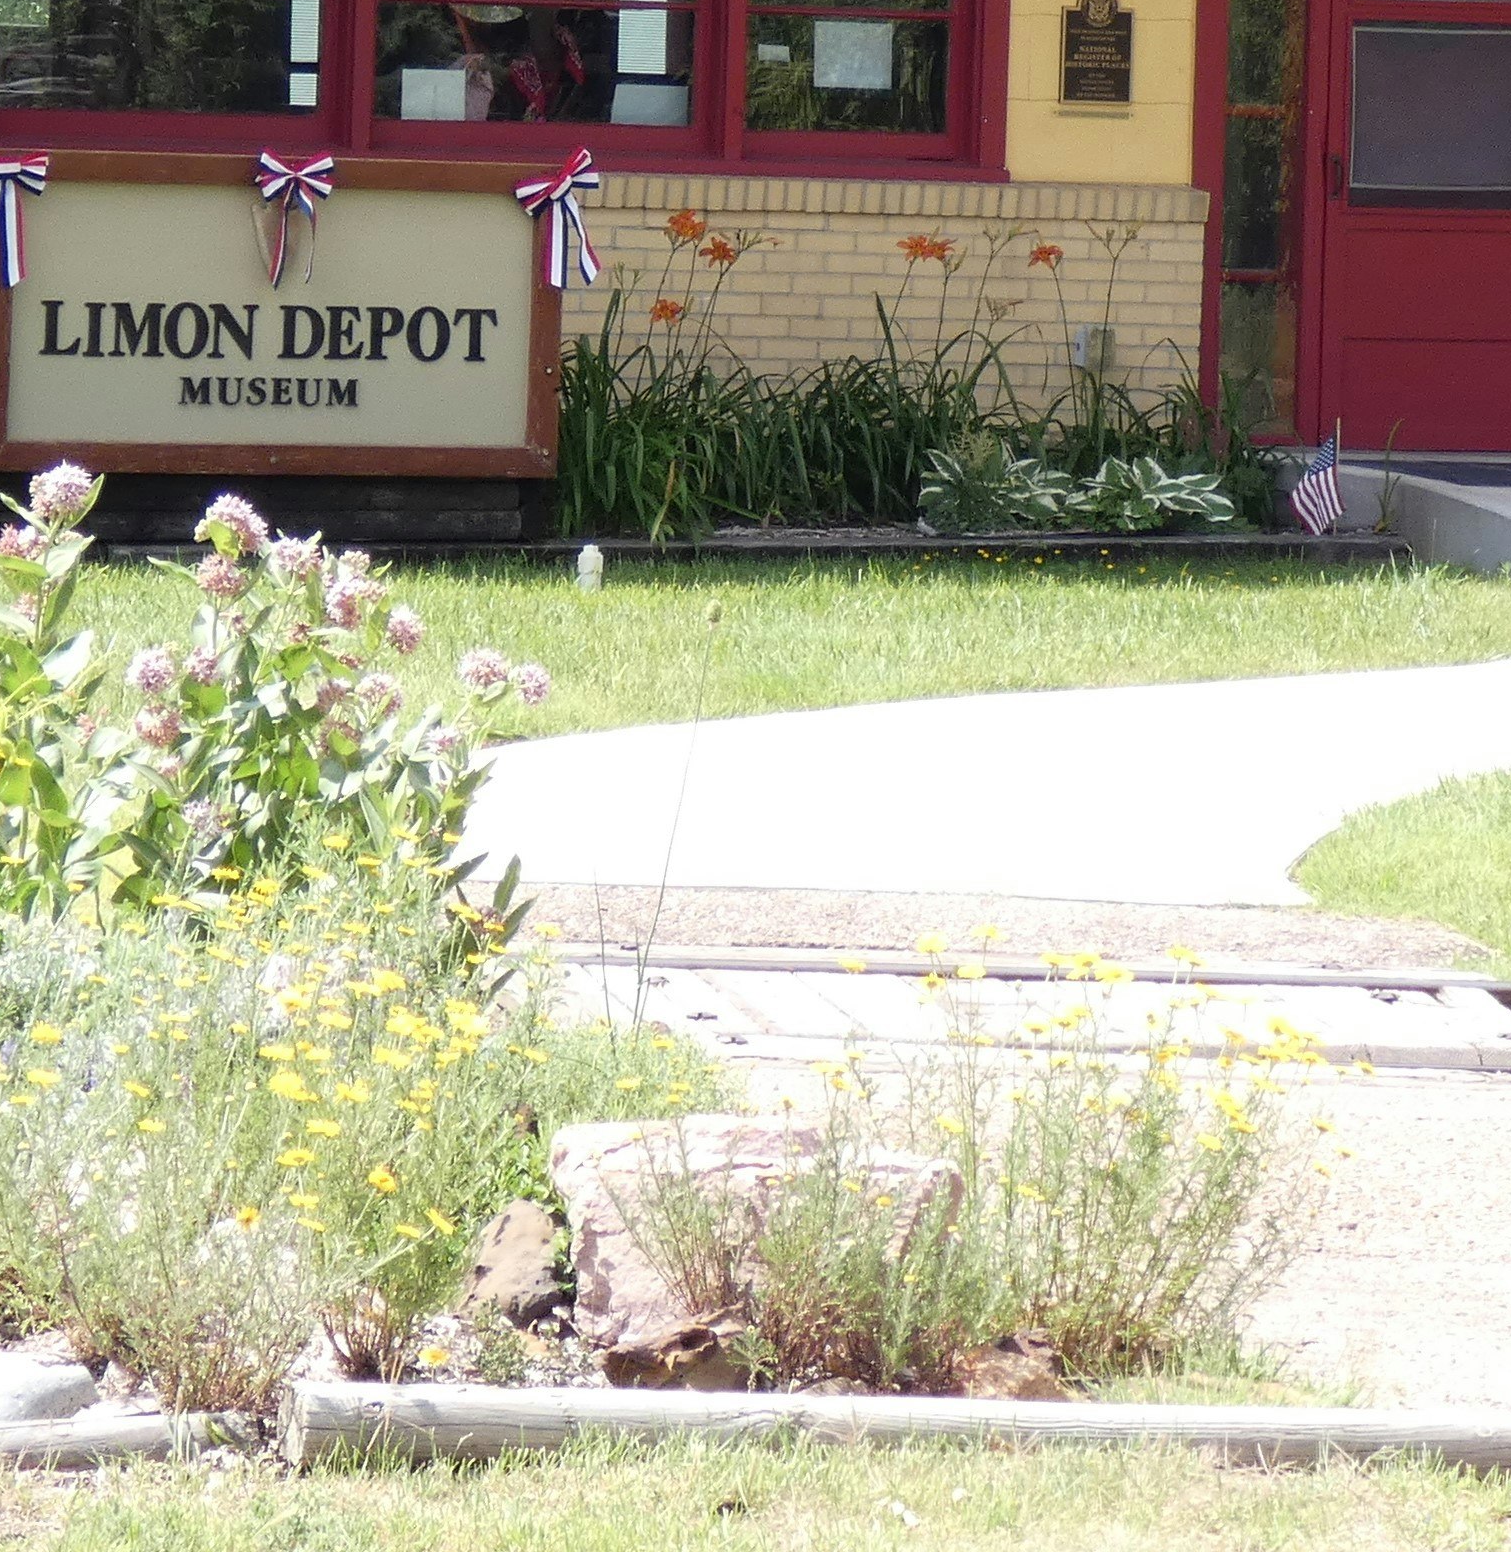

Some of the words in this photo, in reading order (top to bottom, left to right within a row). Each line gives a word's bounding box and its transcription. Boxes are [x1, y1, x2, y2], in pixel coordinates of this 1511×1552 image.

[39, 300, 259, 360] LIMON
[277, 305, 498, 362] DEPOT
[178, 377, 359, 408] MUSEUM
